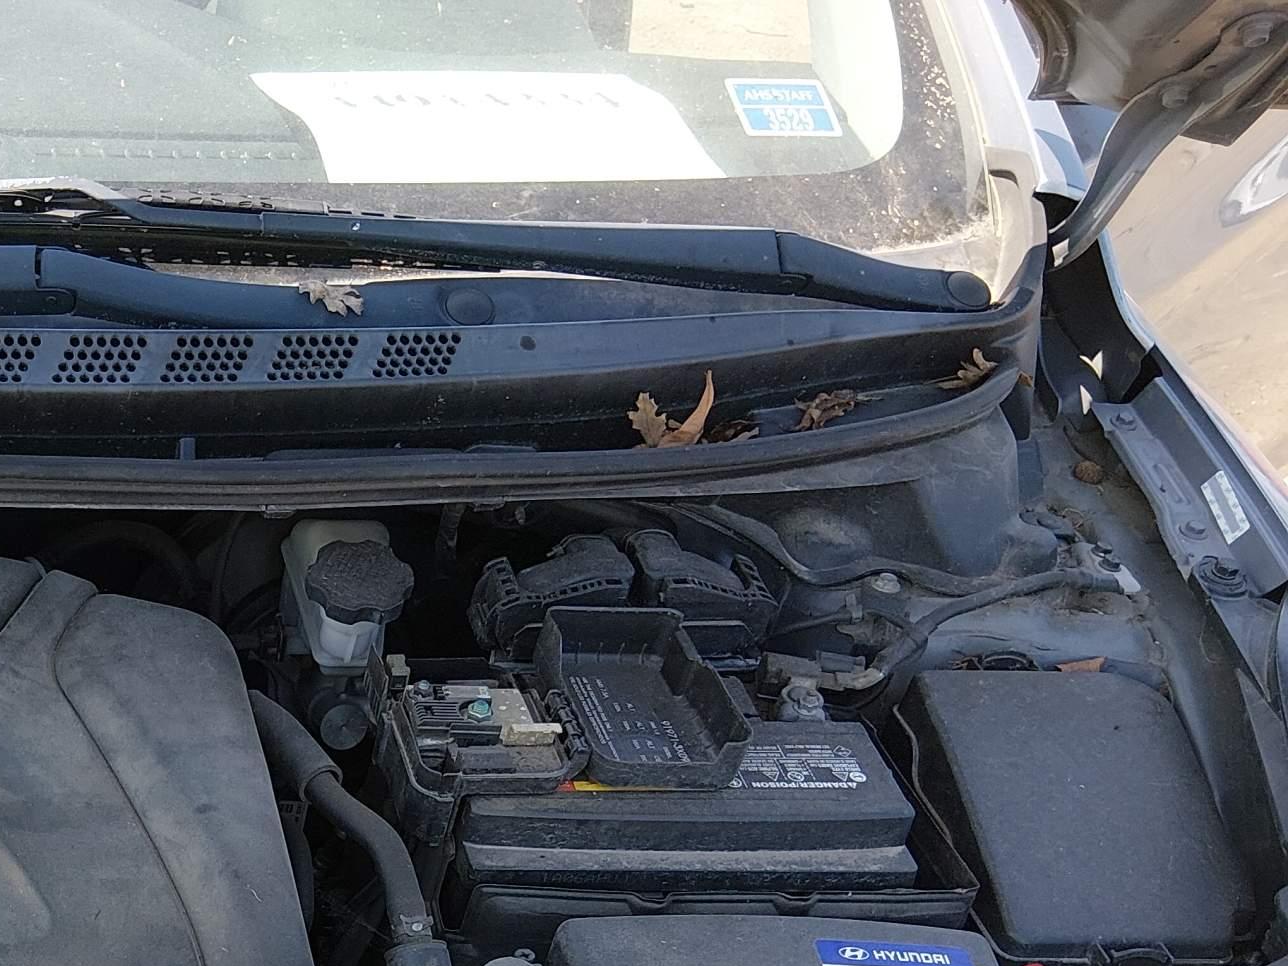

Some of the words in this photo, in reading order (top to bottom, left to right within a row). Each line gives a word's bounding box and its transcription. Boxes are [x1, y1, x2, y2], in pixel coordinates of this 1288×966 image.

[762, 107, 815, 131] 3529
[752, 781, 849, 789] DANGER/POISON
[872, 950, 951, 965] HYUNDAI
